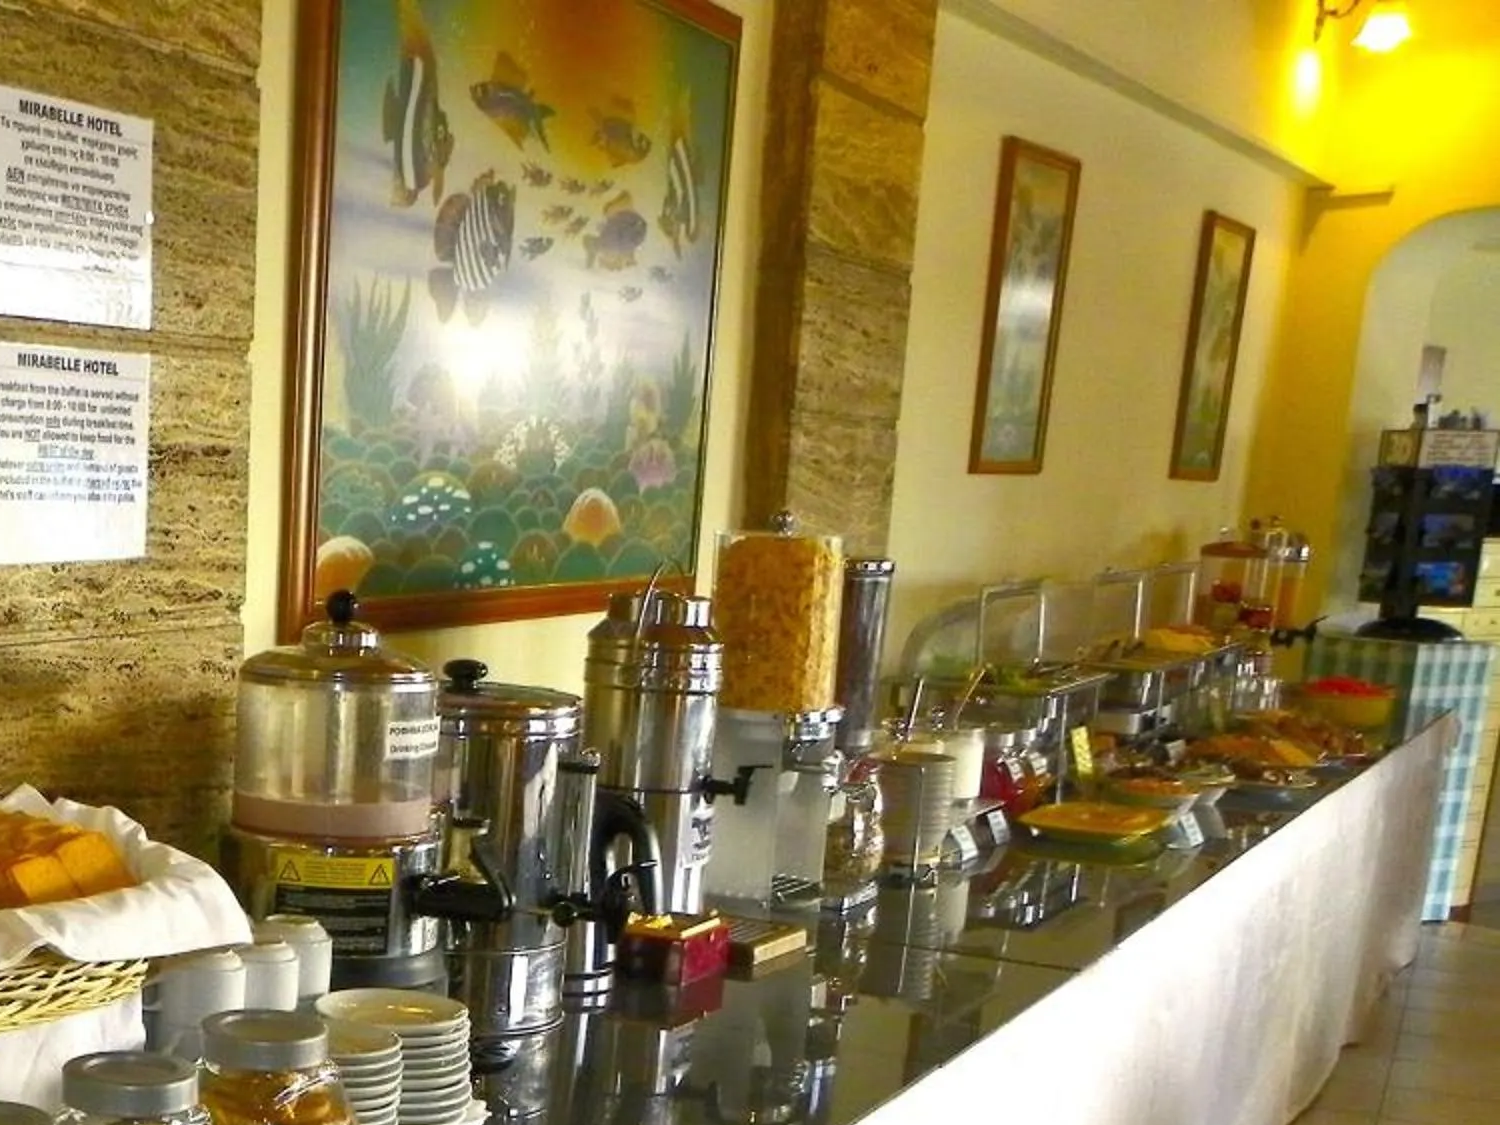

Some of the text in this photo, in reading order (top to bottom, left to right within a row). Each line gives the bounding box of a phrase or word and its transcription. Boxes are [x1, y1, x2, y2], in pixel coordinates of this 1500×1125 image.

[19, 99, 122, 137] MIRABELLE HOTEL
[17, 353, 119, 376] MIRABELLE HOTEL
